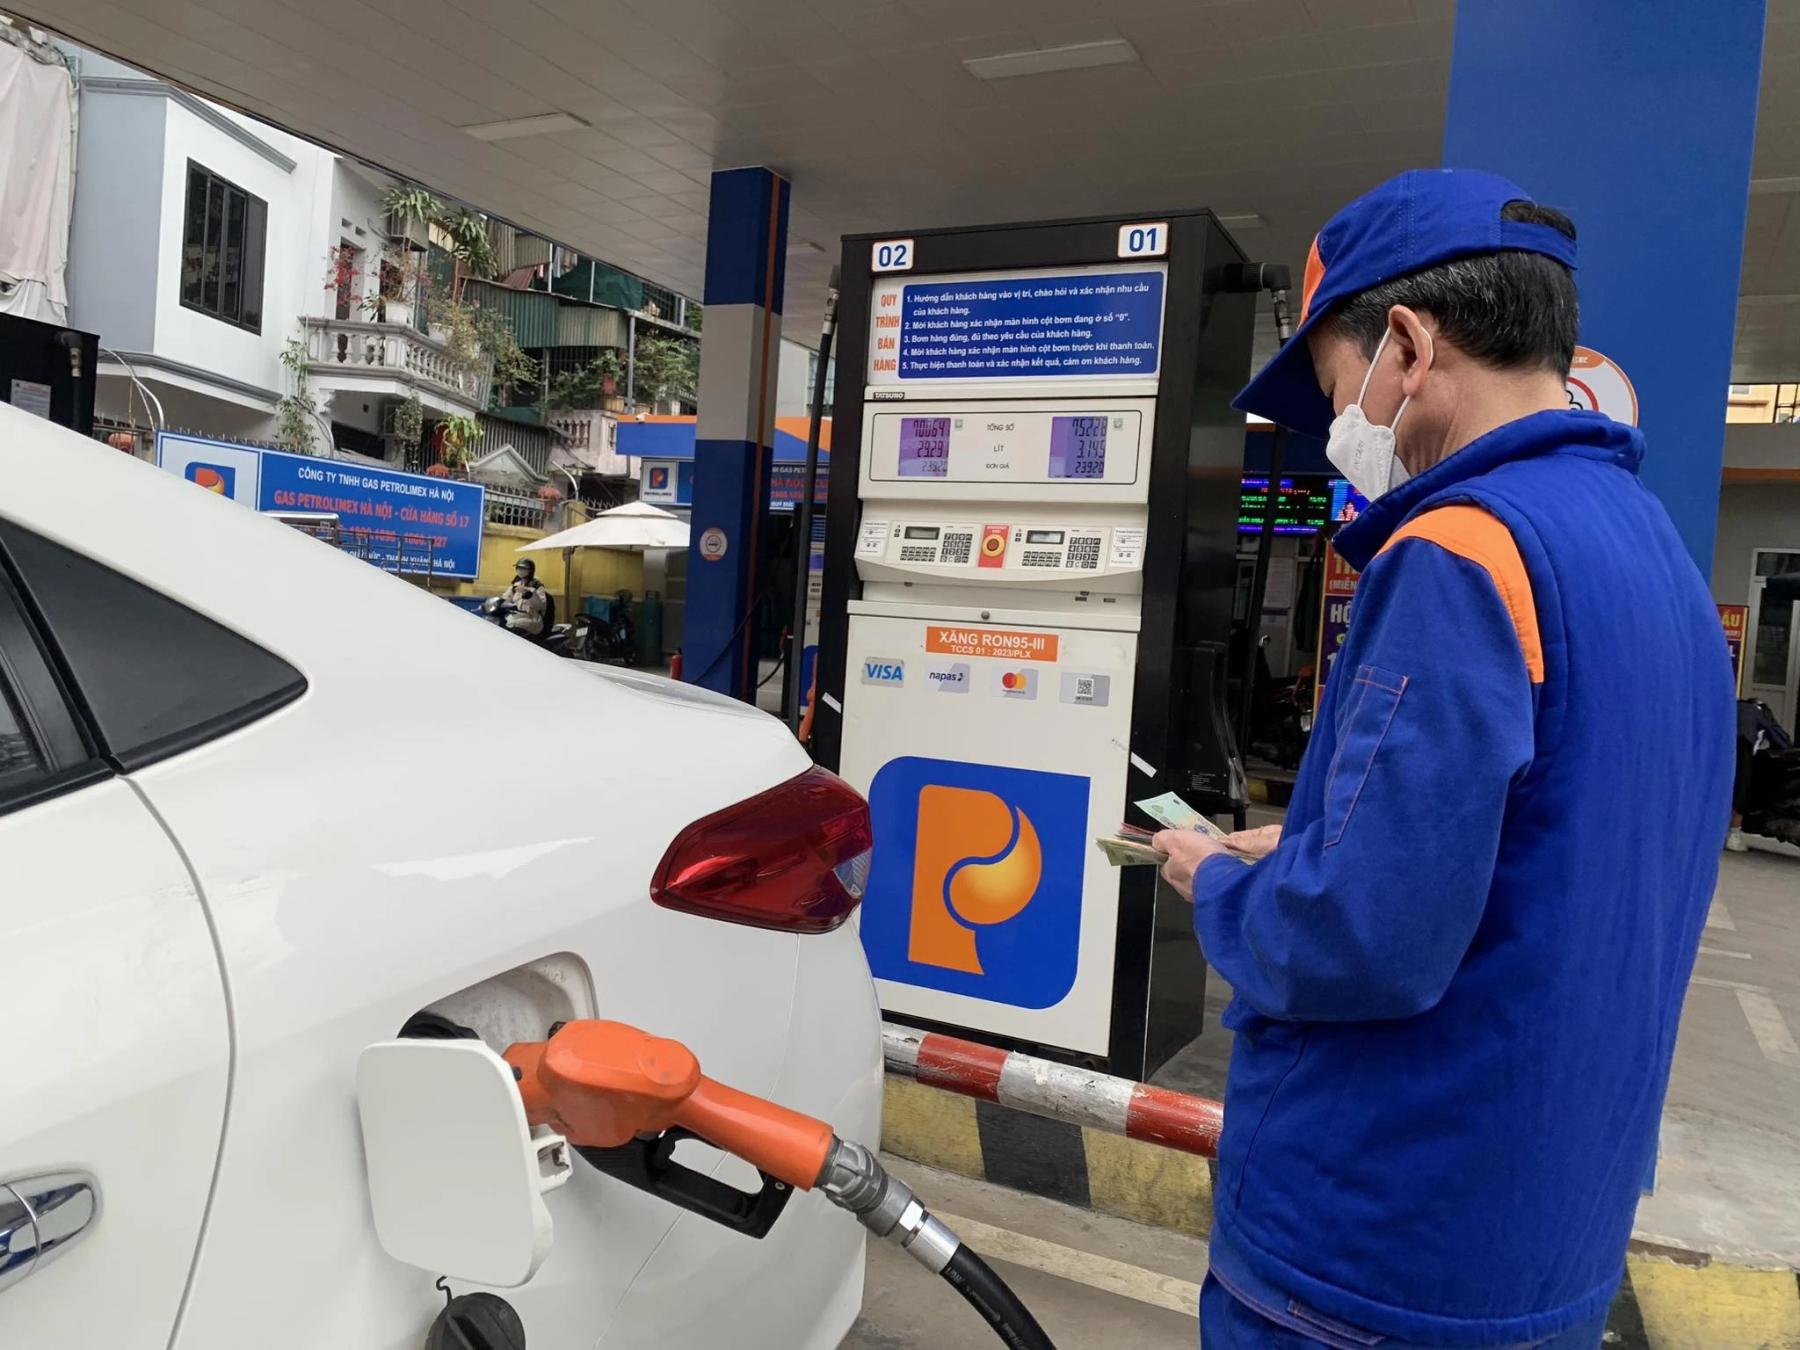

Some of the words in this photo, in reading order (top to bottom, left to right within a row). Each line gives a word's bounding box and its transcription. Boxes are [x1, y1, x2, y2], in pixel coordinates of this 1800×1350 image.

[1129, 228, 1158, 252] 01
[879, 245, 907, 268] 02
[914, 295, 939, 304] Hướng
[941, 293, 954, 301] dẫn
[956, 292, 977, 300] khách
[979, 291, 997, 301] hàng
[1014, 291, 1020, 299] vị
[1035, 289, 1053, 297] chào
[1055, 288, 1067, 296] hỏi
[1069, 287, 1078, 295] và
[1080, 287, 1093, 295] xác
[1095, 286, 1115, 295] nhận
[1118, 285, 1132, 293] nhu
[1135, 282, 1149, 292] cầu
[881, 295, 897, 307] QUY
[913, 308, 926, 316] của
[928, 307, 949, 315] khách
[951, 307, 971, 316] hàng.
[876, 315, 899, 328] TRÌNH
[912, 321, 926, 329] Mời
[928, 320, 948, 329] khách
[950, 320, 968, 329] hàng
[984, 319, 1002, 328] nhận
[1005, 318, 1020, 326] màn
[1022, 317, 1039, 325] hình
[1041, 316, 1053, 326] cột
[1055, 316, 1072, 324] bơm
[1074, 316, 1093, 325] đang
[1104, 313, 1113, 322] số
[912, 335, 929, 343] Bơm
[930, 334, 948, 343] hàng
[971, 332, 981, 340] đủ
[1001, 332, 1014, 341] yêu
[1016, 330, 1029, 339] cầu
[1031, 330, 1045, 338] của
[1046, 329, 1069, 338] khách
[1072, 330, 1093, 339] hàng.
[878, 337, 894, 350] BÁN
[911, 348, 925, 356] Mời
[926, 347, 947, 356] khách
[949, 347, 966, 357] hàng
[982, 346, 1001, 355] nhận
[1002, 345, 1018, 353] màn
[1020, 344, 1037, 353] hình
[1039, 343, 1051, 353] cột
[1053, 343, 1070, 352] bơm
[1072, 343, 1094, 351] trước
[1096, 342, 1108, 350] khi
[1110, 342, 1132, 350] thanh
[1135, 342, 1155, 350] toán.
[874, 358, 896, 371] HÀNG
[911, 362, 929, 370] Thực
[930, 361, 945, 370] hiện
[968, 360, 985, 368] toán
[1011, 358, 1030, 368] nhận
[1032, 357, 1044, 367] kết
[1094, 356, 1118, 365] khách
[1120, 356, 1142, 366] hàng.
[298, 466, 323, 481] CÔNG
[326, 472, 337, 484] TY
[339, 474, 360, 487] TNHH
[362, 478, 378, 490] GAS
[381, 482, 427, 497] PETROLIMEX
[429, 487, 439, 499] HÀ
[442, 489, 454, 503] NỘI
[275, 490, 295, 505] GAS
[297, 493, 359, 513] PETROLIMEX
[361, 498, 373, 516] HÀ
[375, 501, 393, 520] NỘI
[400, 505, 418, 521] CỬA
[420, 508, 444, 526] HÀNG
[446, 511, 457, 527] SỐ
[460, 516, 470, 528] 17
[444, 558, 455, 571] NỘI
[1330, 601, 1352, 628] HỘ
[940, 630, 978, 645] XĂNG
[982, 635, 1045, 650] RON95-III
[952, 645, 974, 654] TCCS
[992, 649, 1031, 658] 2023/PLX
[865, 664, 903, 680] VISA
[930, 672, 956, 682] napas
